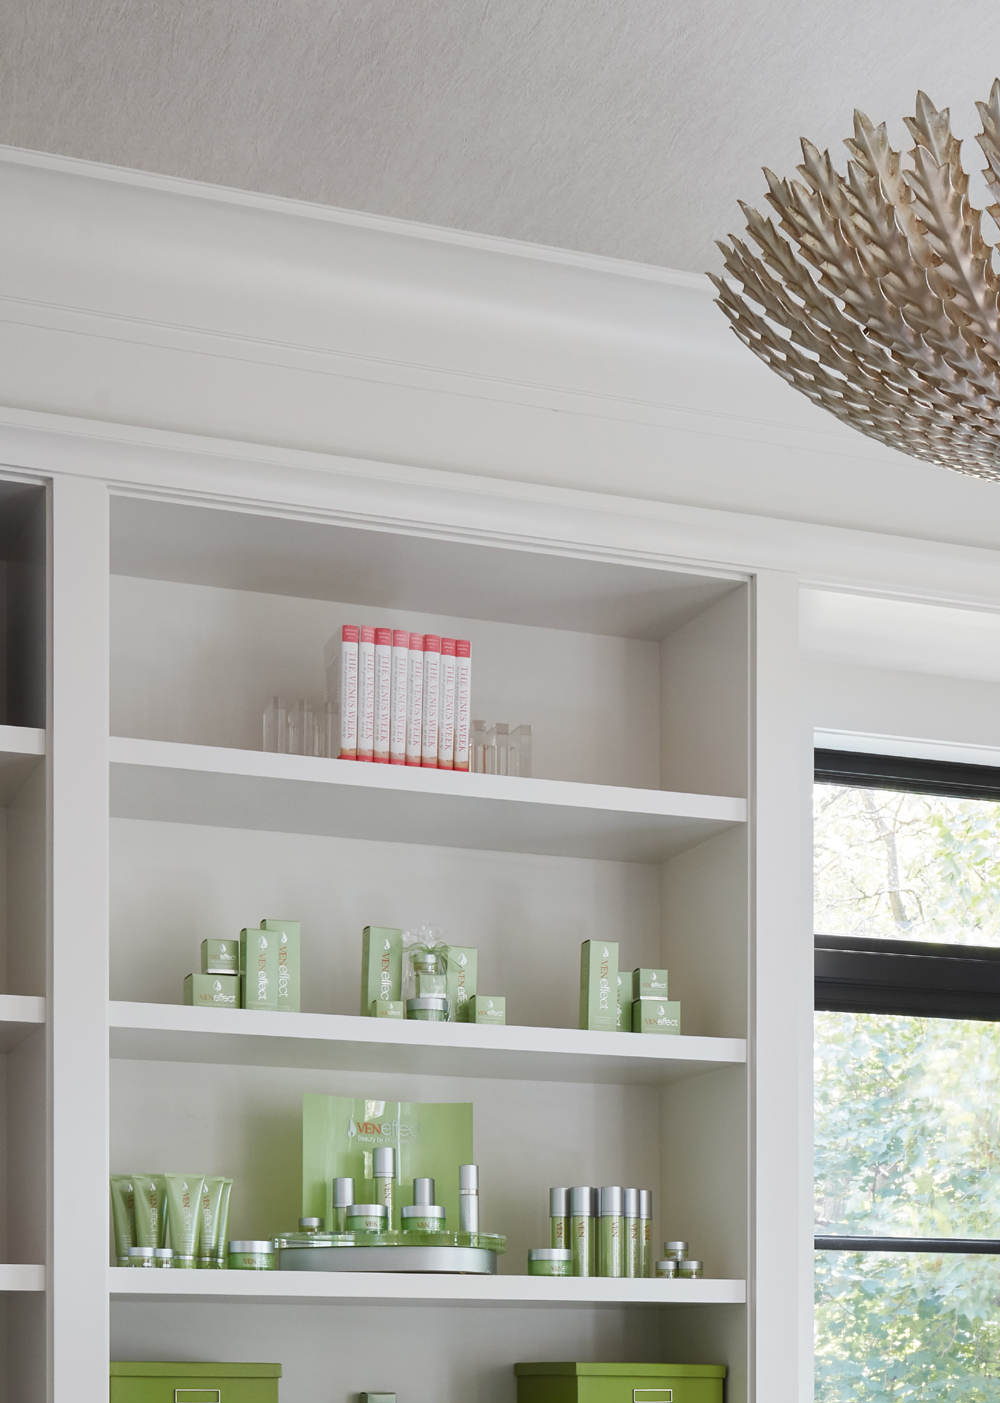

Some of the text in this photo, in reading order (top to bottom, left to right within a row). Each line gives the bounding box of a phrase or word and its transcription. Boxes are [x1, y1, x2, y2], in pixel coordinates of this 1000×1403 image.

[398, 657, 406, 678] THE
[348, 676, 356, 708] VENUS
[381, 679, 389, 711] VENUS
[428, 661, 438, 748] THE VENUS WEEK
[446, 688, 454, 720] VENUS
[347, 711, 355, 739] WEEK
[459, 666, 468, 752] THE VENUS WEEK
[380, 714, 388, 742] WEEK
[397, 715, 405, 743] WEEK
[413, 718, 421, 746] WEEK
[445, 722, 453, 751] WEEK
[259, 953, 269, 1001] VENeffect
[280, 946, 291, 998] VENeffect
[600, 960, 611, 1010] VENeffect
[199, 992, 236, 1003] VENeffect
[645, 1017, 679, 1027] VENeffect
[356, 1120, 423, 1138] VENeffect
[376, 1136, 387, 1145] by
[151, 1194, 159, 1233] VENeffect
[183, 1193, 192, 1232] VENeffect
[203, 1195, 213, 1235] VENeffect
